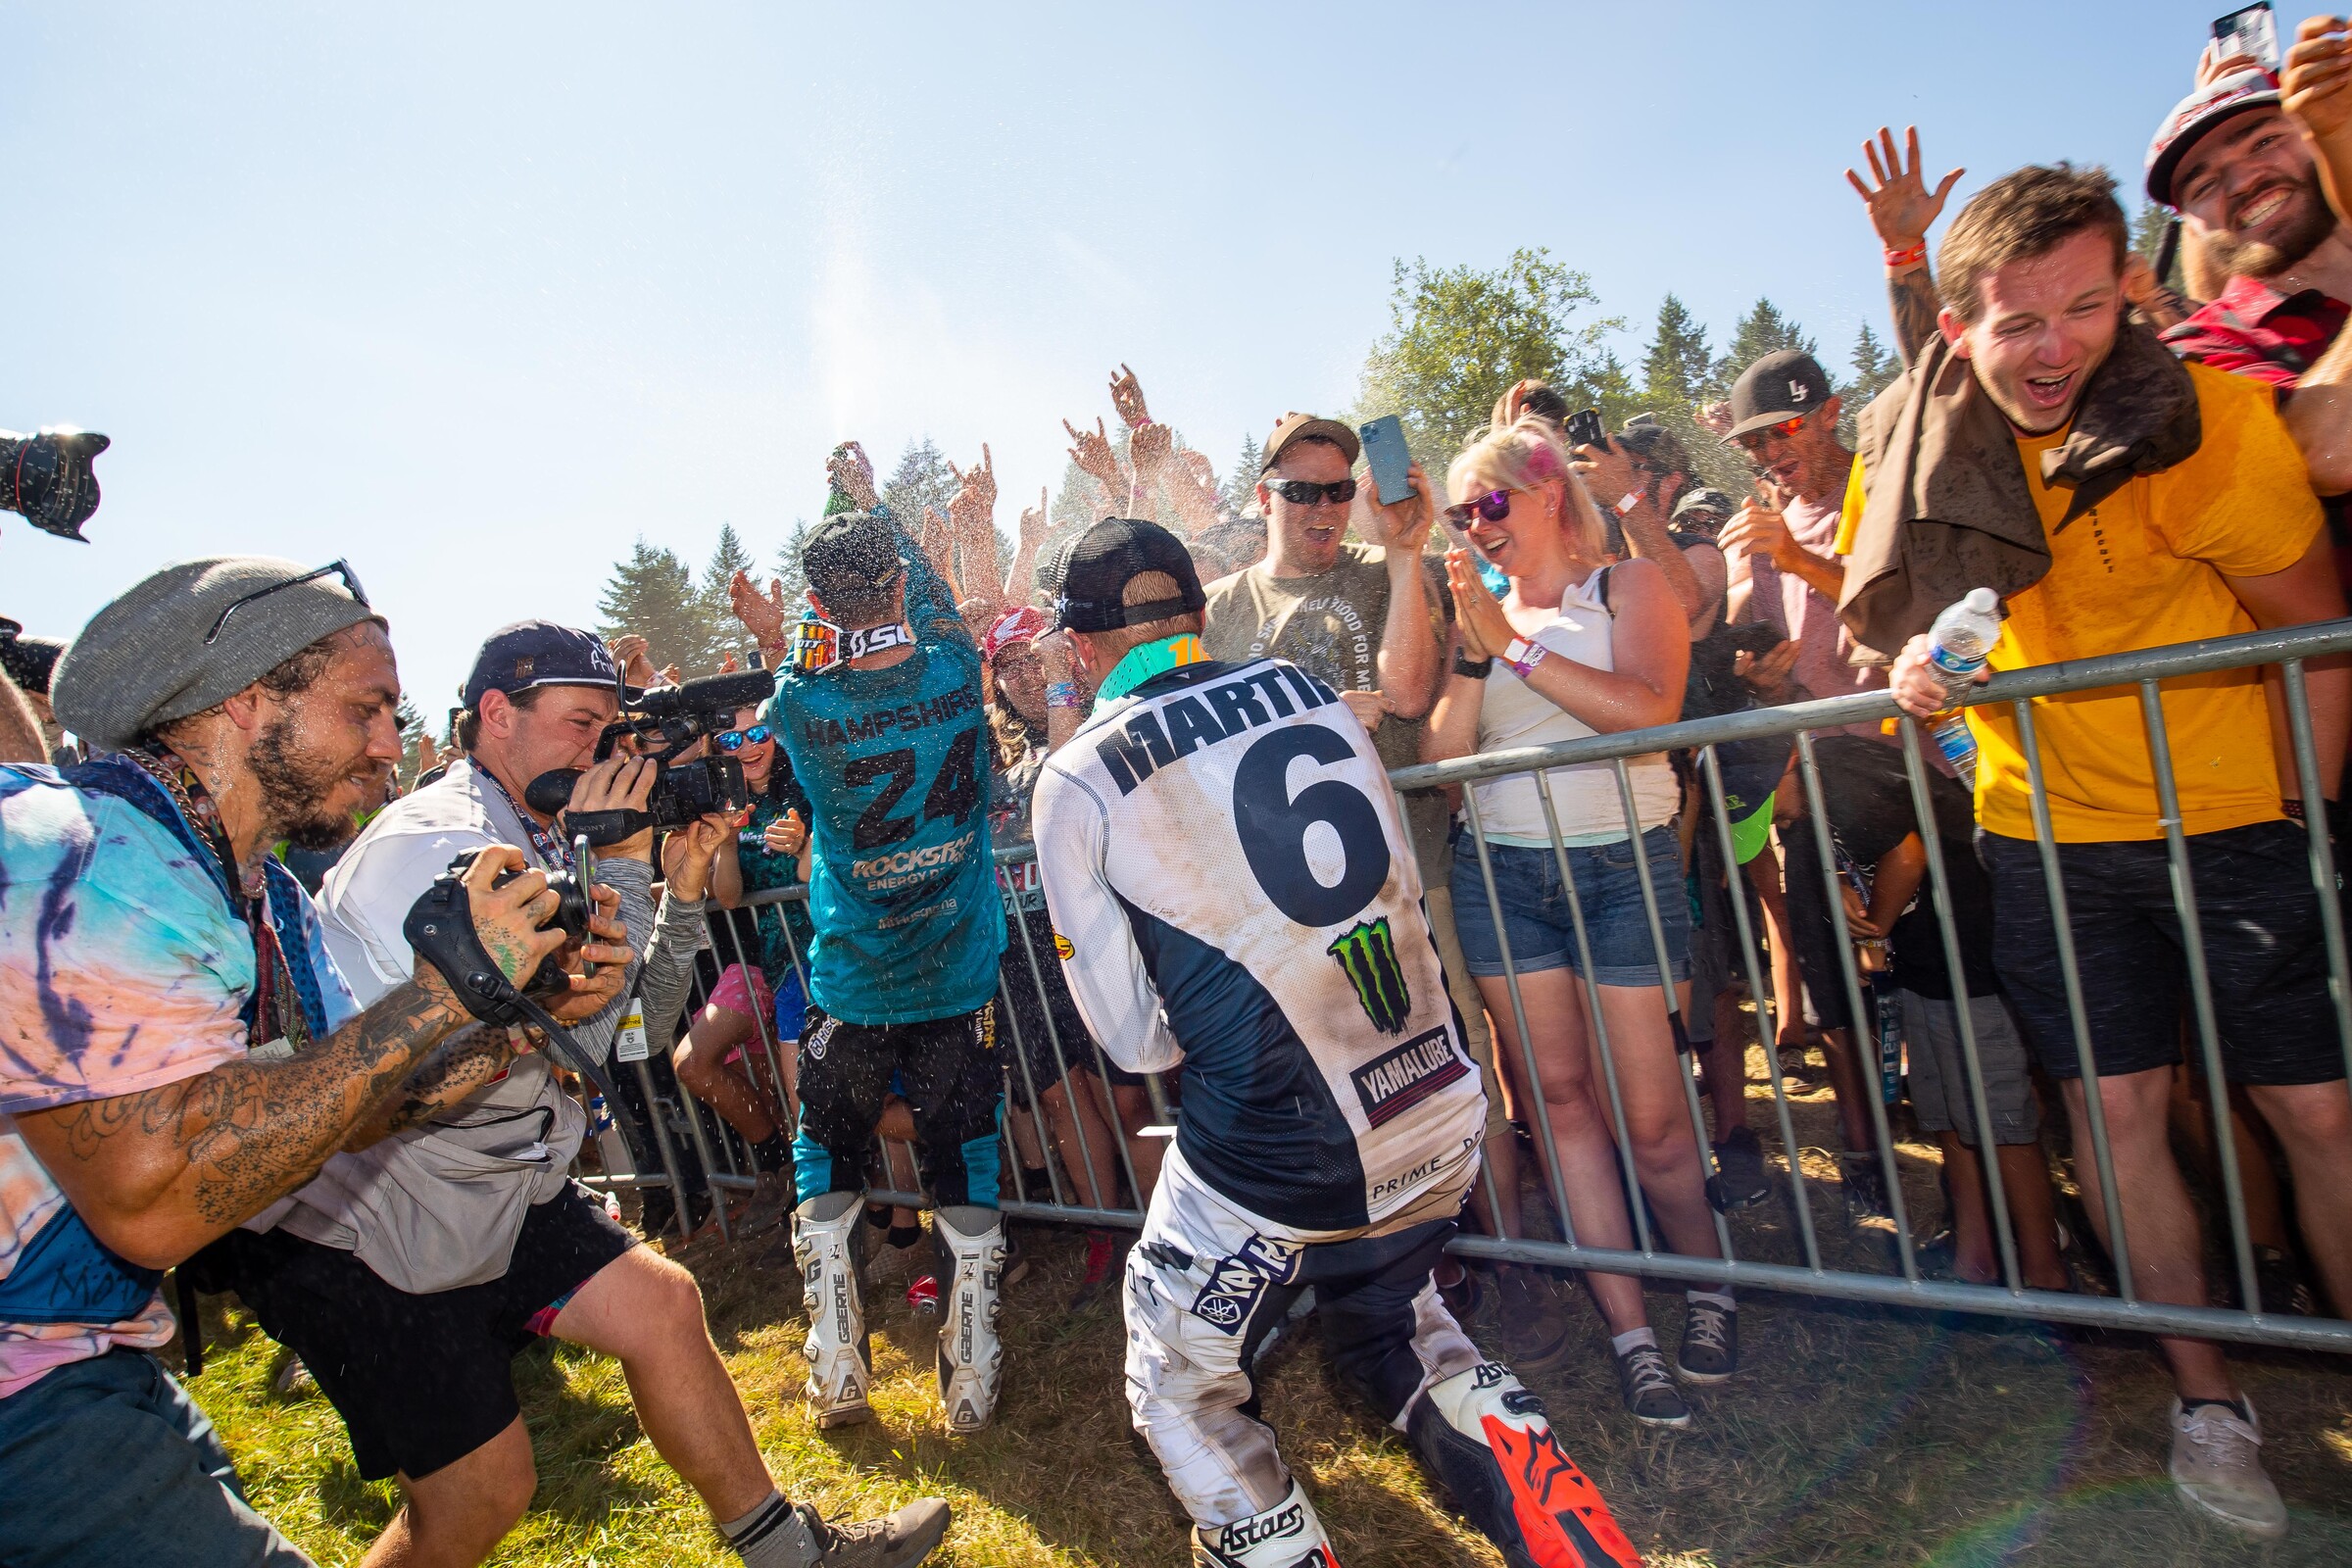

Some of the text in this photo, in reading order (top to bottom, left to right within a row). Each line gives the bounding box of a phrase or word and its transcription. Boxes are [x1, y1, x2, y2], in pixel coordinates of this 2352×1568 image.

[1352, 634, 1370, 665] FOR
[844, 725, 981, 850] 24
[1233, 723, 1391, 928] 6
[867, 870, 927, 893] ENERGY
[1360, 1034, 1454, 1104] YAMALUBE
[1372, 1157, 1442, 1200] PRIME
[826, 1243, 844, 1260] 24
[960, 1261, 979, 1278] 24
[1220, 1502, 1305, 1555] Astars
